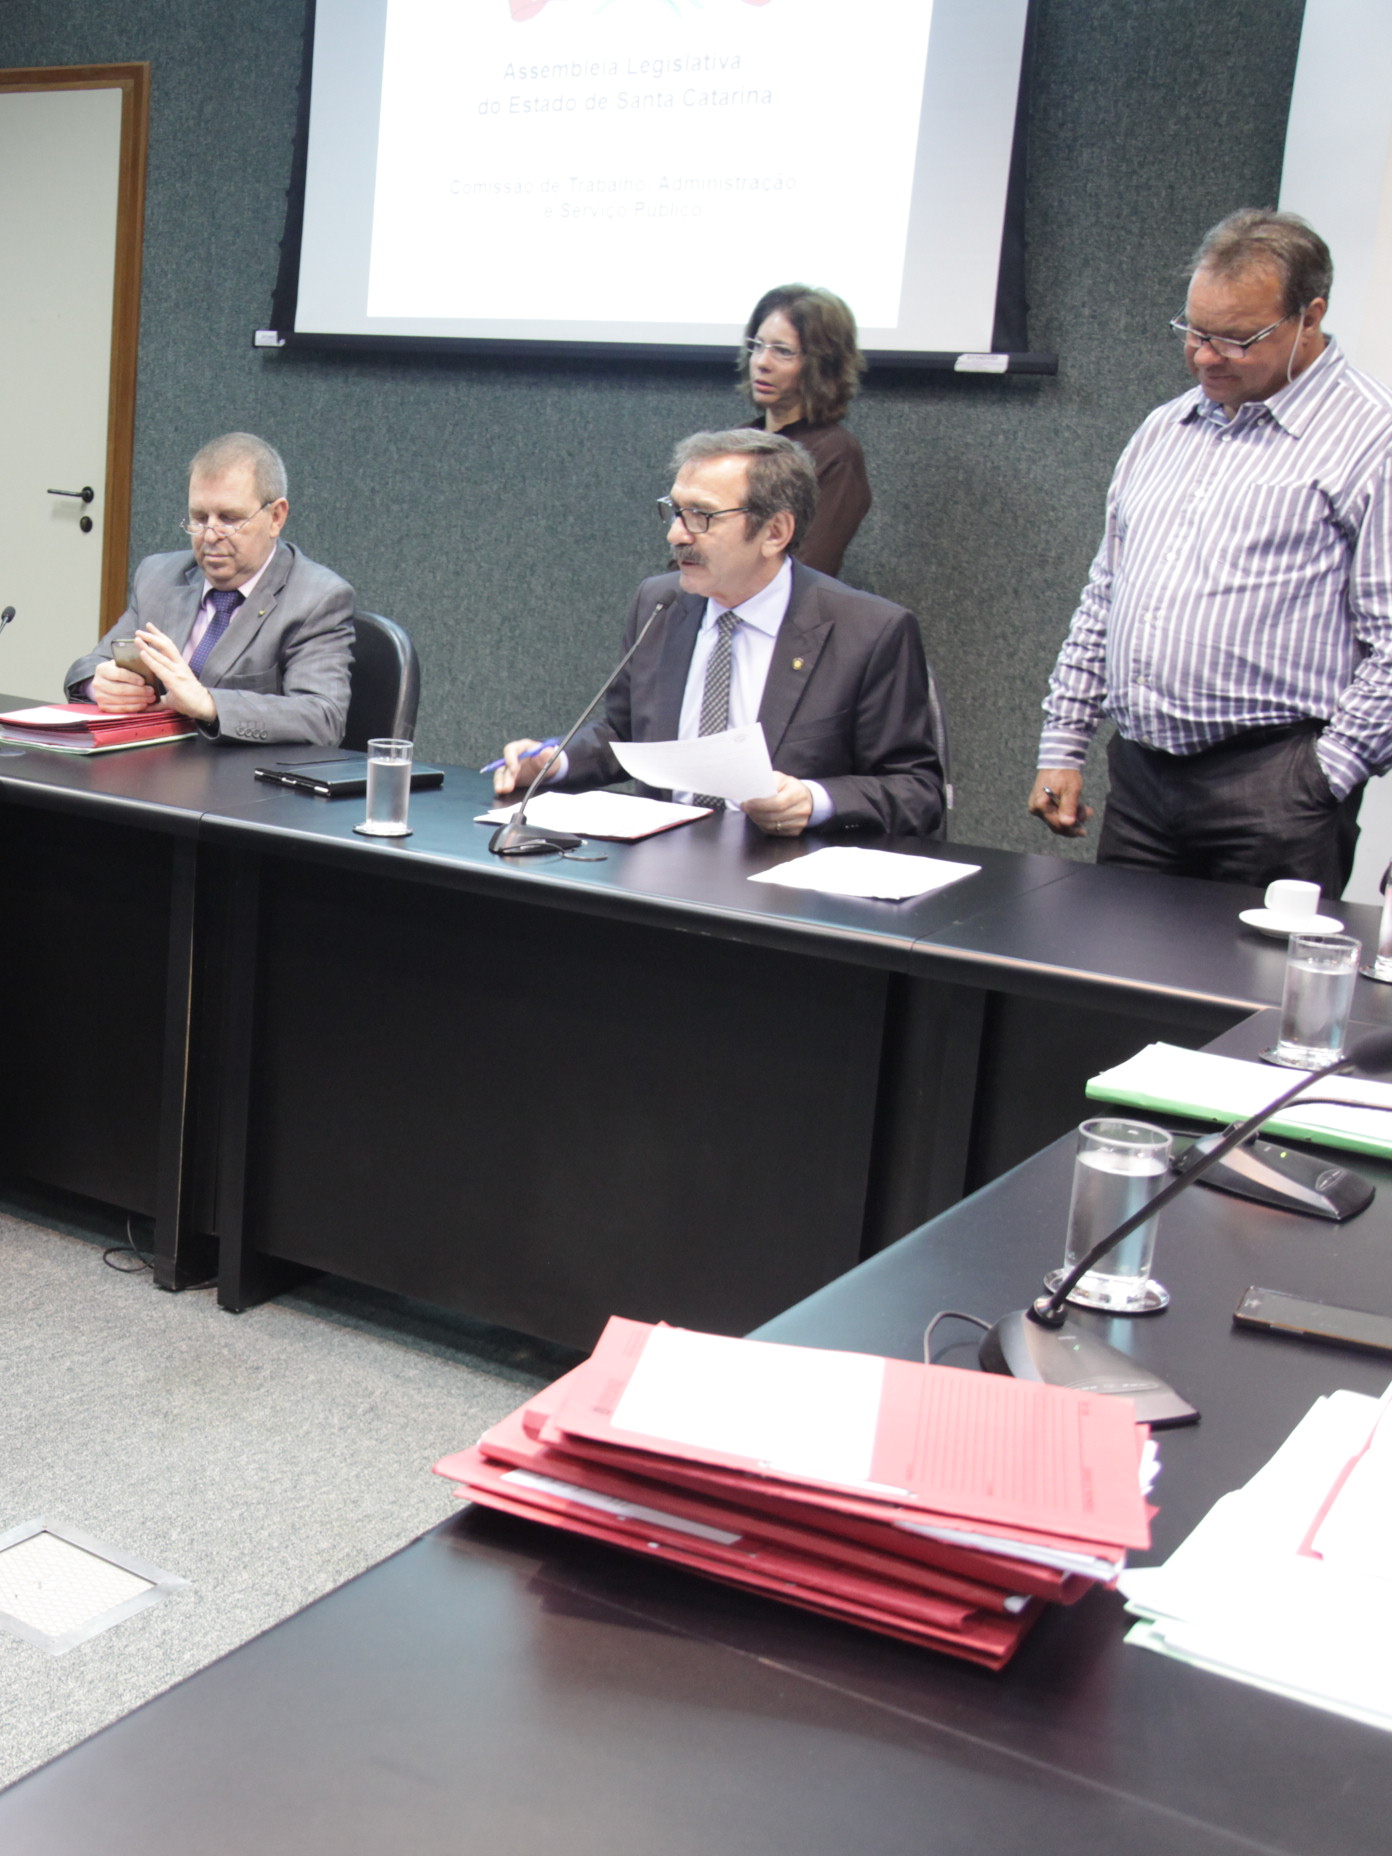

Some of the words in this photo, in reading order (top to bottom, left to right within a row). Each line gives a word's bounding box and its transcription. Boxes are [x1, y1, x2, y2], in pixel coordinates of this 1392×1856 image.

[503, 59, 619, 80] Assembleia
[627, 53, 741, 78] Legislativa
[478, 98, 501, 115] do
[509, 94, 577, 114] Estado
[585, 93, 608, 111] de
[617, 91, 674, 110] Santa
[683, 86, 773, 107] Catarina
[540, 178, 561, 193] de
[659, 172, 796, 193] Administração
[544, 206, 554, 218] e
